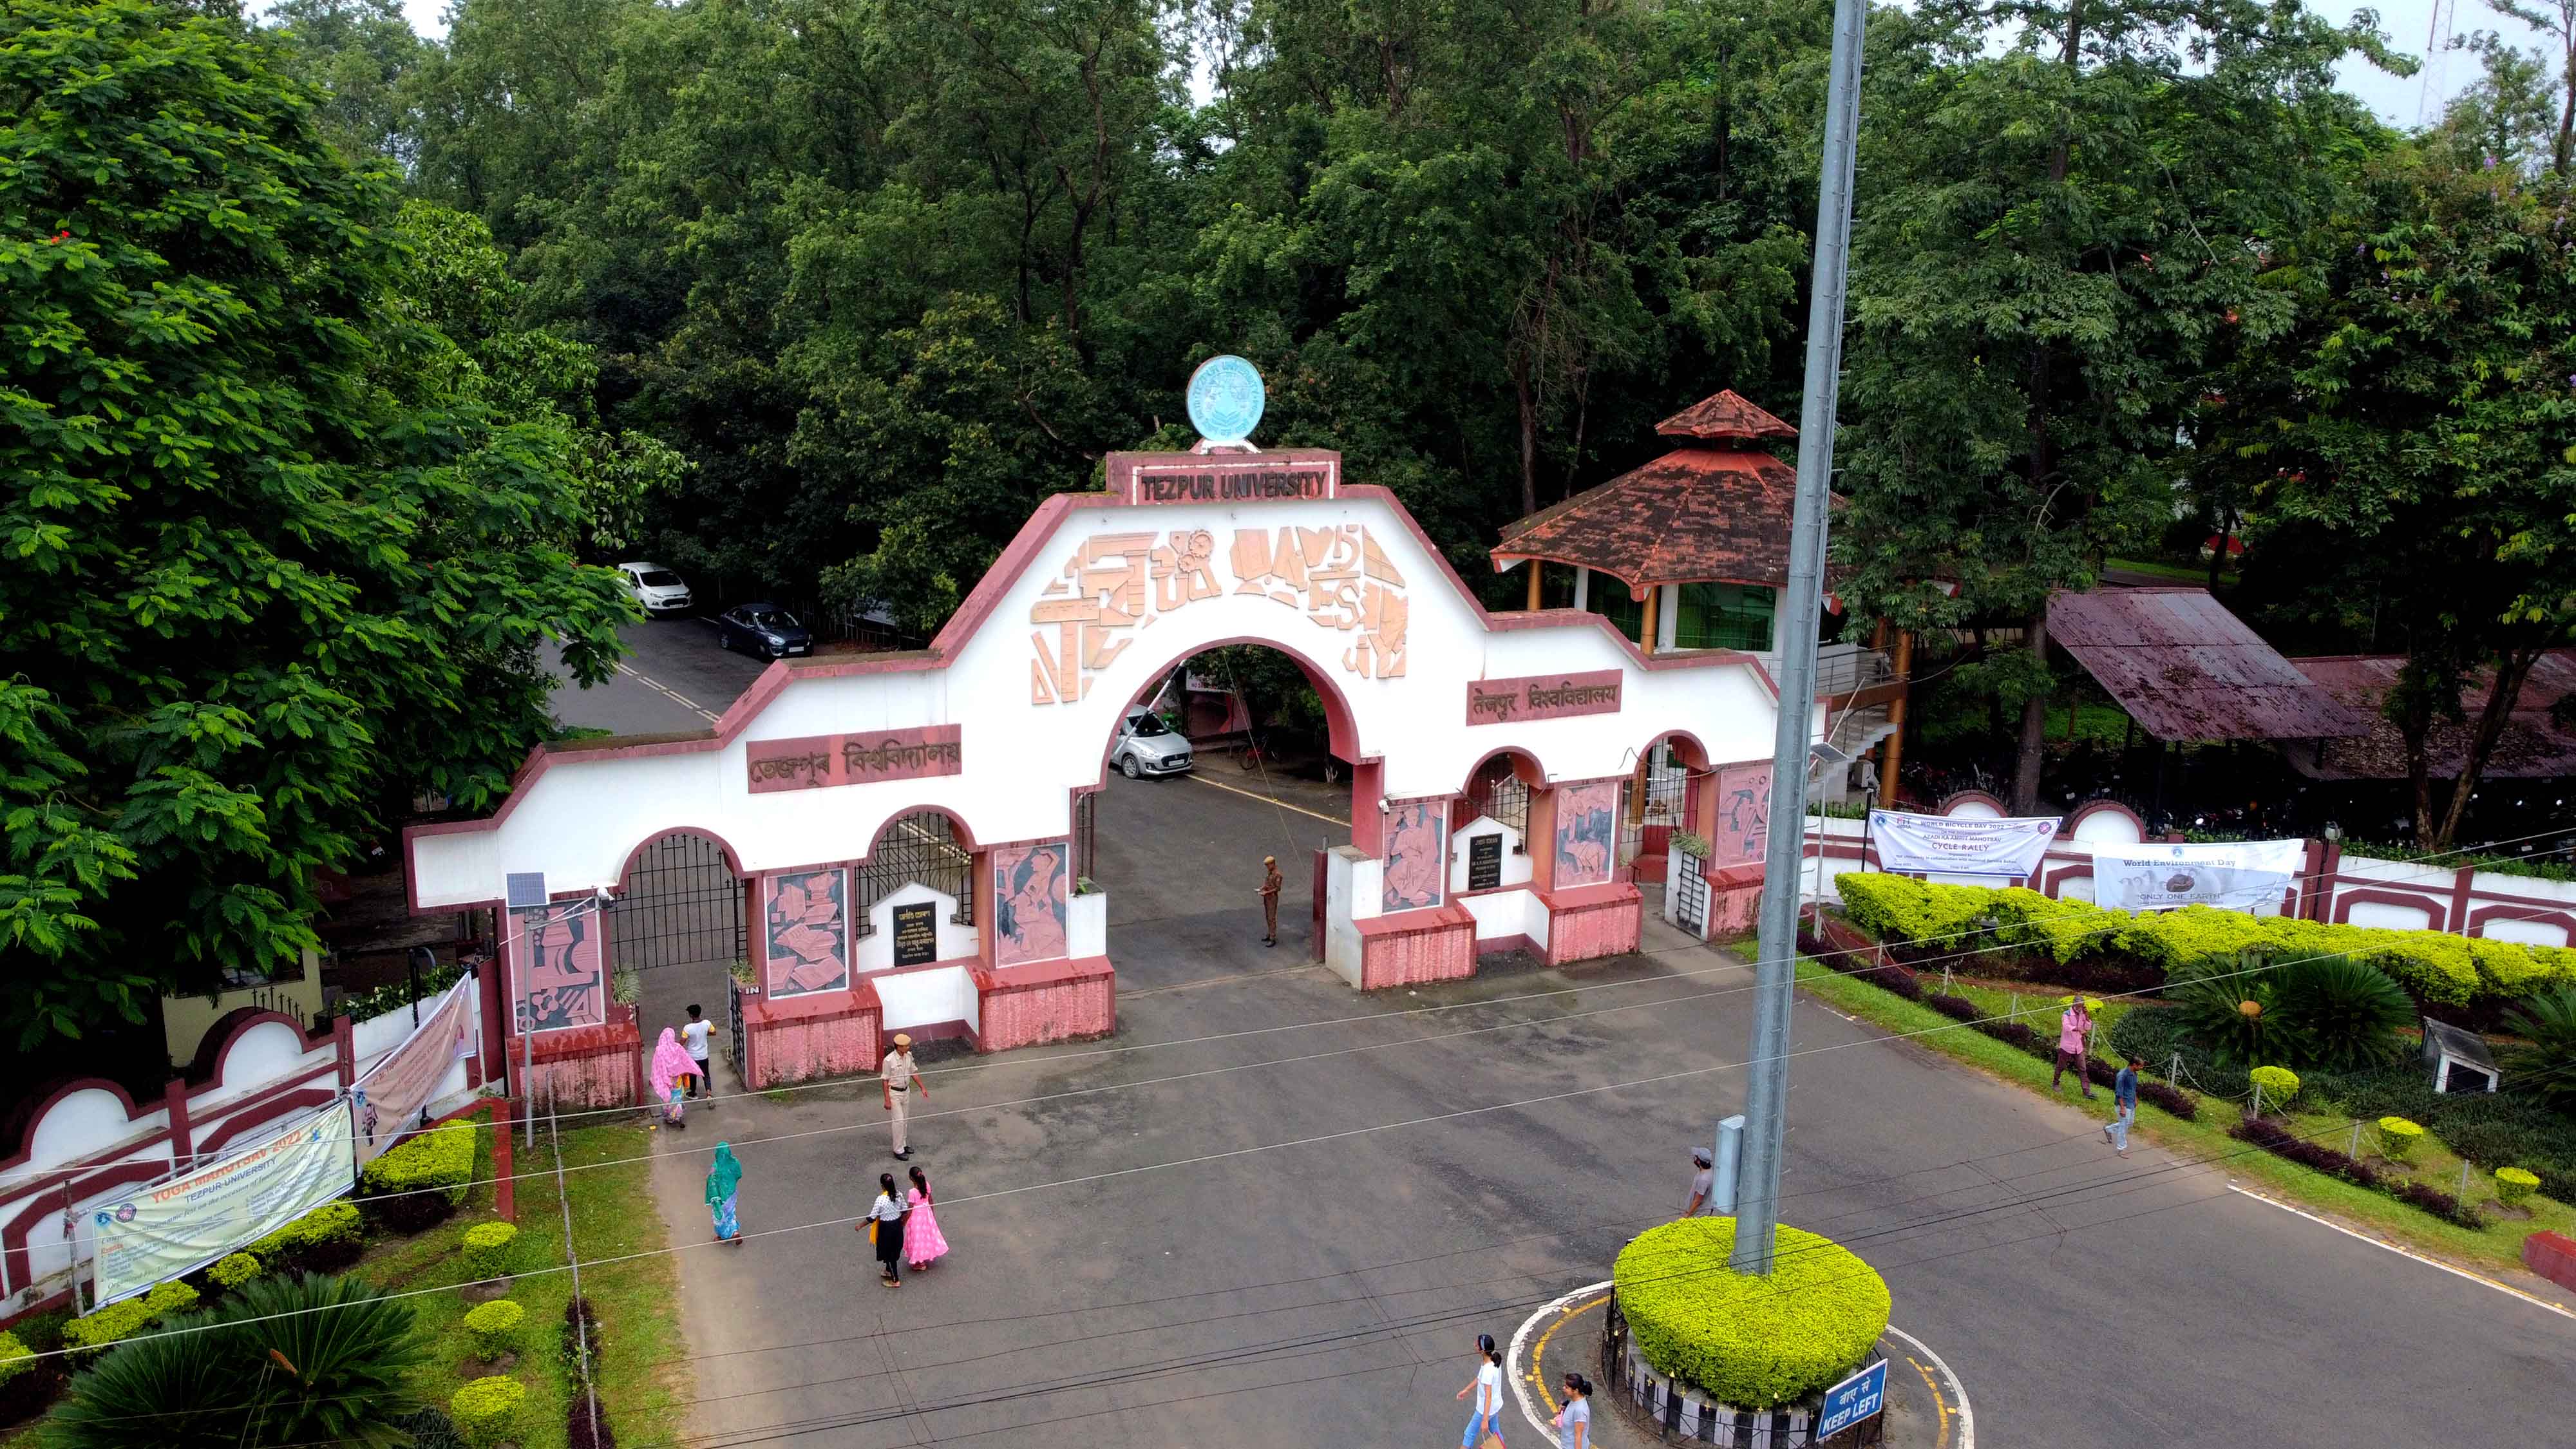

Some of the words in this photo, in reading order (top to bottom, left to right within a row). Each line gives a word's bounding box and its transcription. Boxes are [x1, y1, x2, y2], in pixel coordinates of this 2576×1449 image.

[1141, 474, 1215, 501] TEZPUR
[1220, 471, 1327, 499] UNIVERSITY
[1473, 687, 1519, 721] तेजपुर
[1527, 680, 1618, 710] विश्वविद्यालय
[2217, 859, 2236, 867] Day
[152, 1180, 191, 1204] YOGA
[194, 1149, 268, 1186] MAHOTSAV
[272, 1130, 302, 1153] 2022
[185, 1181, 223, 1204] TEZPUR
[223, 1156, 278, 1186] UNIVERSITY
[1861, 1376, 1871, 1393] से
[1822, 1408, 1851, 1434] KEEP
[1852, 1392, 1879, 1418] LEFT
